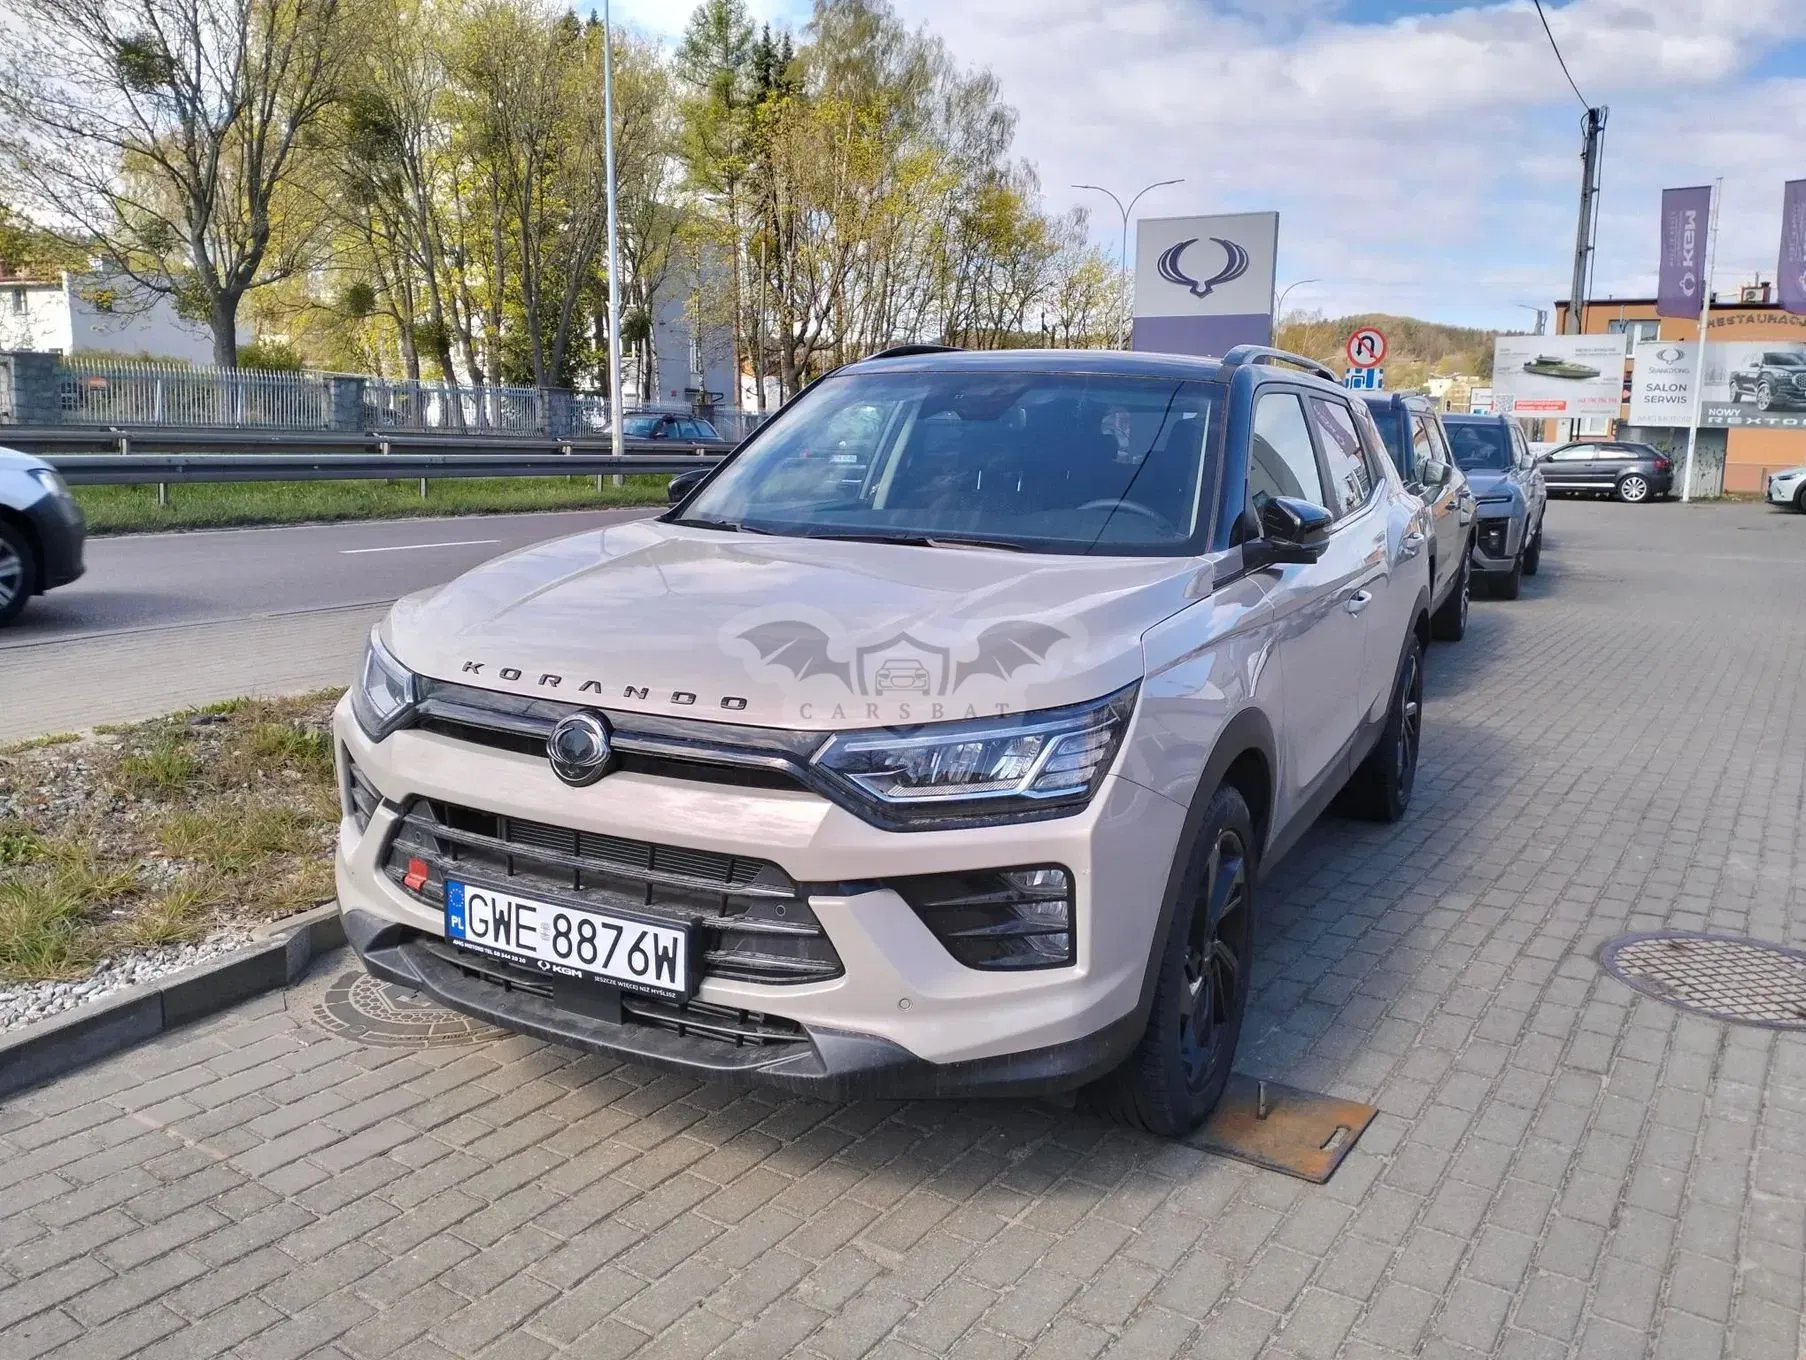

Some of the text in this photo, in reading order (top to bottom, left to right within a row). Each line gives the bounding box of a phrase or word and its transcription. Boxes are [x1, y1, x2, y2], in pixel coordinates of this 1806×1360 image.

[1682, 210, 1697, 267] KGM
[1646, 383, 1688, 392] SALON
[1644, 395, 1688, 404] SERWIS
[1708, 408, 1741, 416] NOWY
[1708, 416, 1806, 426] REXTO
[461, 660, 749, 711] KORANDO
[451, 915, 464, 931] PL
[468, 893, 678, 984] GWE 8876W
[552, 964, 582, 979] KGM
[594, 976, 617, 986] JESZCZE
